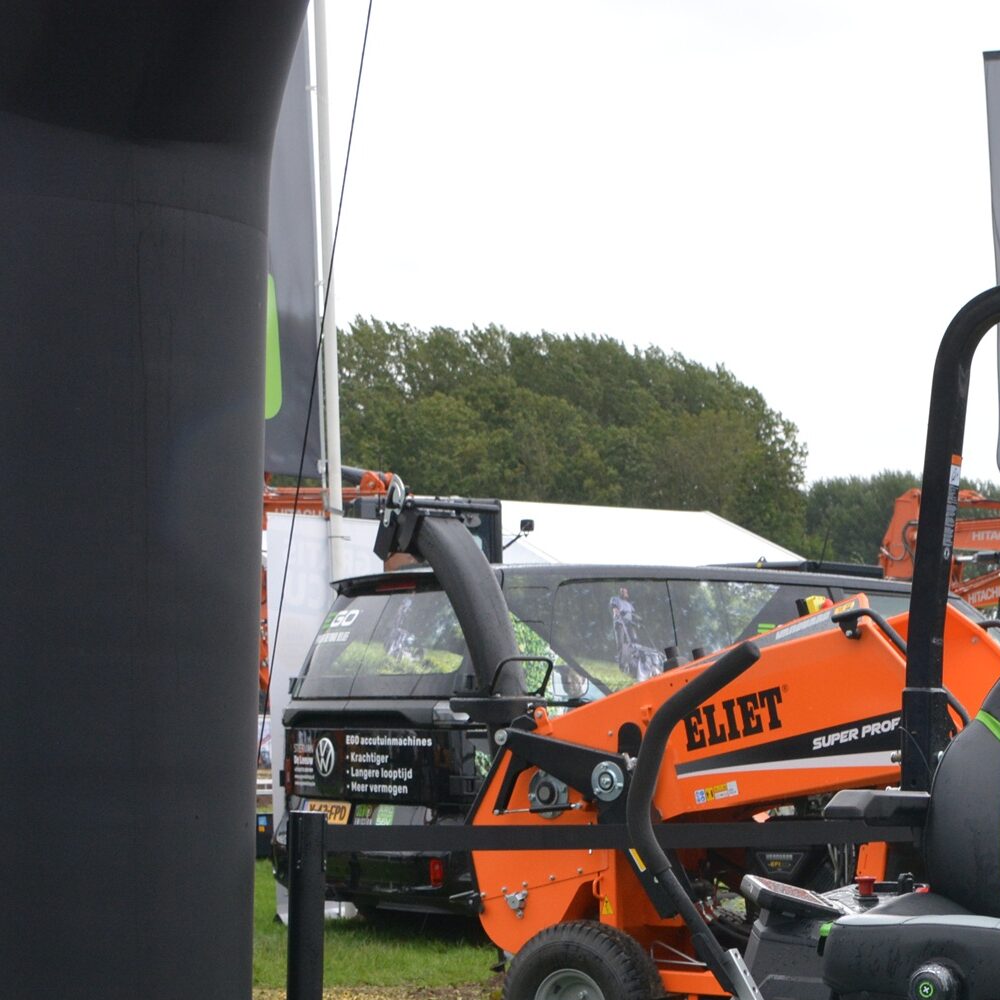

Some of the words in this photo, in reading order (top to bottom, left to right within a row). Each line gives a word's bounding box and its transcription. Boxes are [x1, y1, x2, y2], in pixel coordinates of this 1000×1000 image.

[682, 686, 783, 752] ELIET
[345, 734, 360, 746] EGO
[360, 736, 433, 747] accutuinmachines
[812, 728, 859, 751] SUPER
[350, 752, 390, 766] Krachtiger
[351, 767, 380, 781] Langere
[380, 768, 414, 781] looptijd
[351, 782, 369, 793] Meer
[369, 784, 409, 797] vermogen
